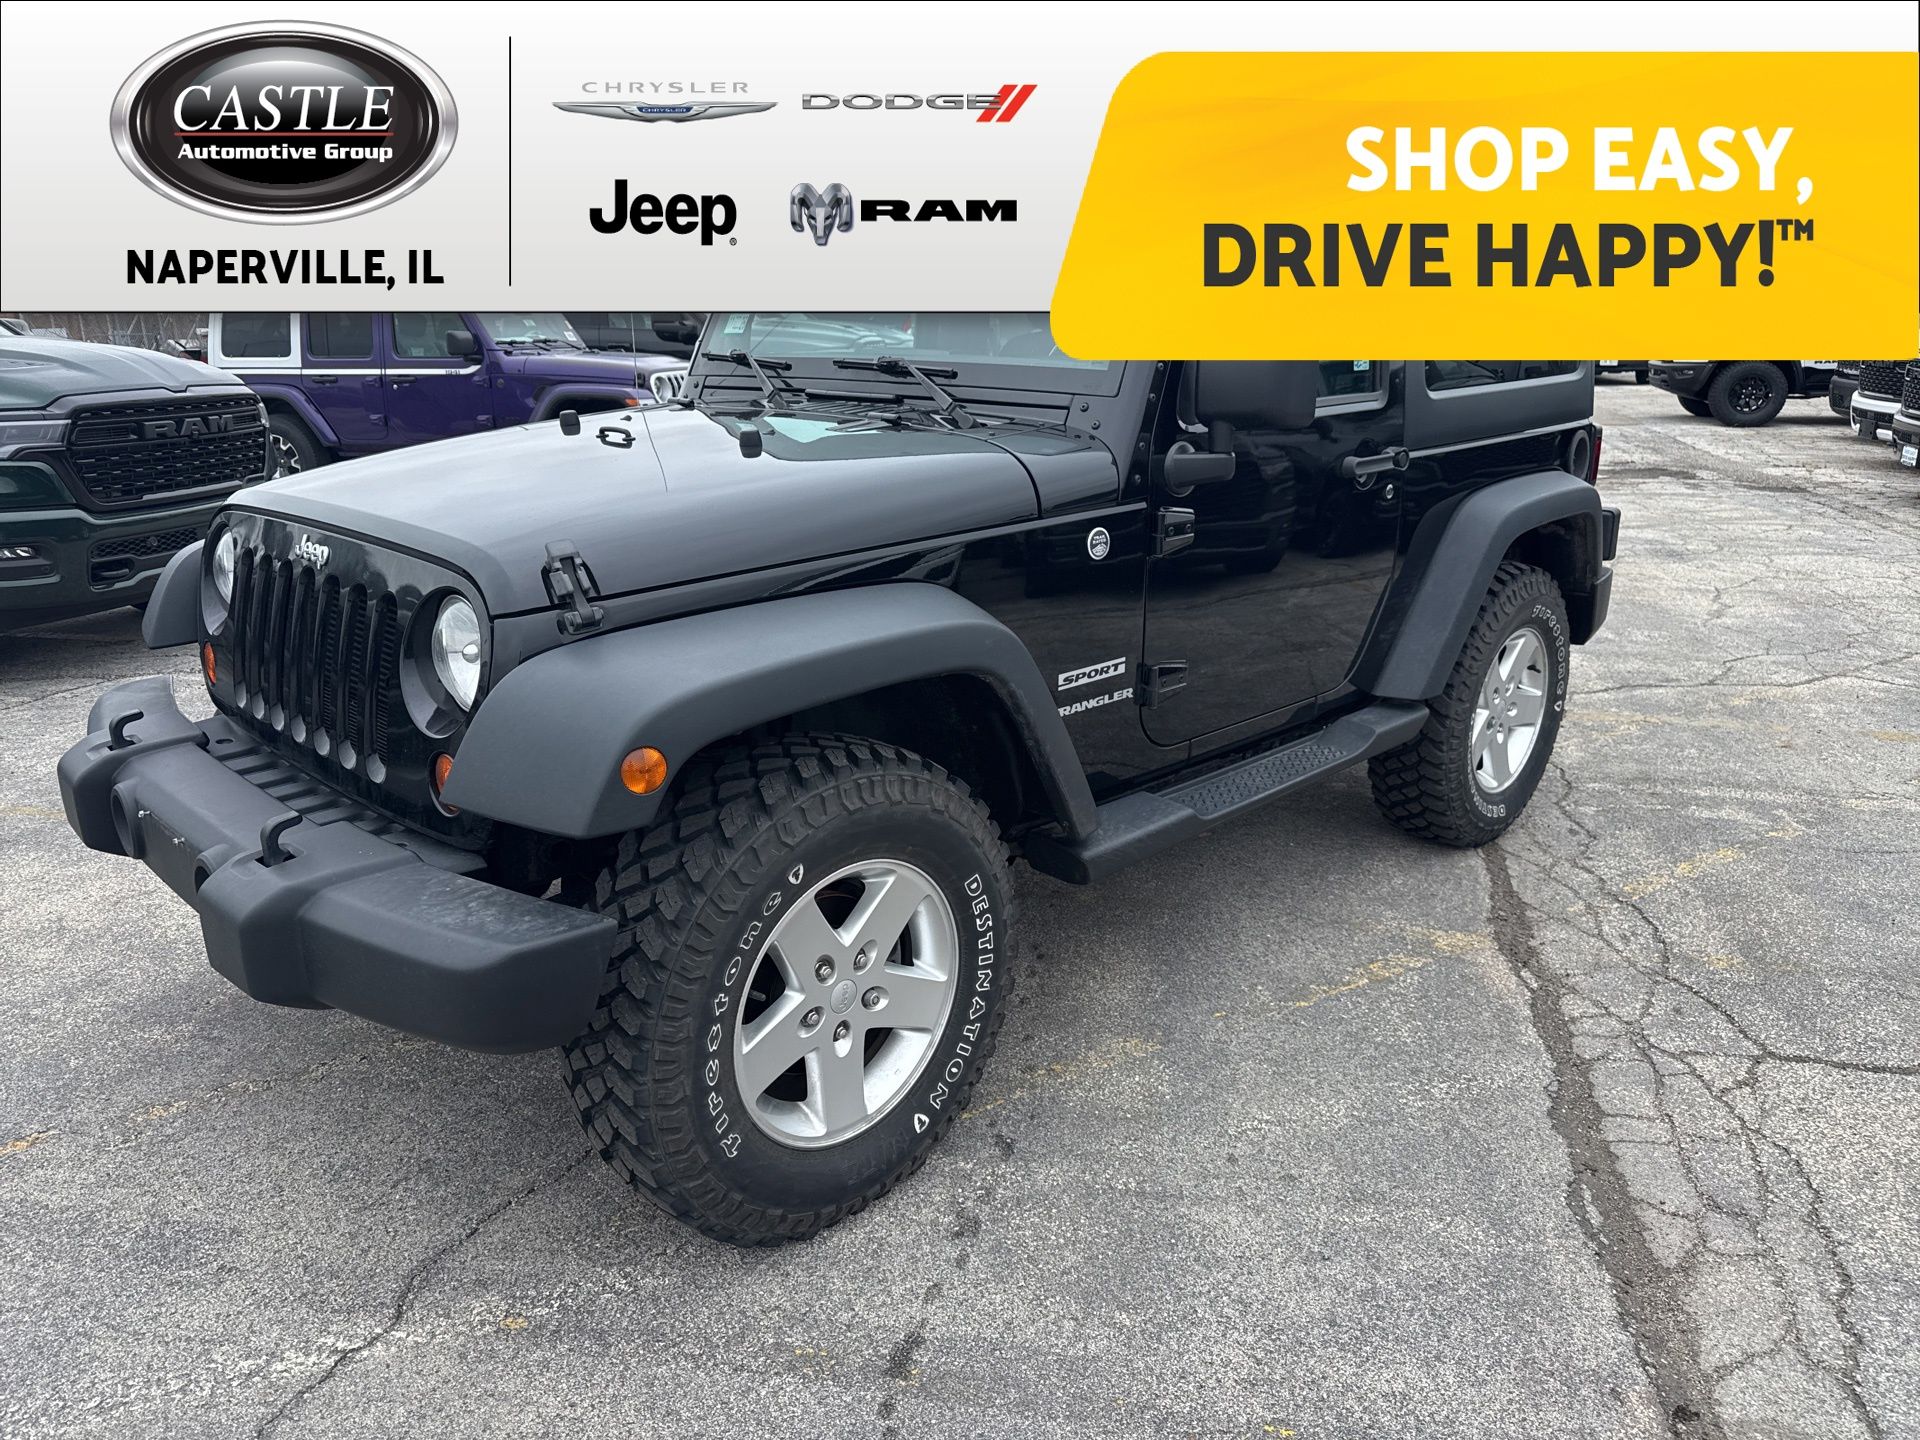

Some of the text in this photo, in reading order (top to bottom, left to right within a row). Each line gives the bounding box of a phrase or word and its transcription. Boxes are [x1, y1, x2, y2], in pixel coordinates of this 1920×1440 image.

[143, 415, 234, 440] RAM
[295, 534, 329, 570] Jeep
[1531, 605, 1566, 696] Firestone
[1061, 662, 1123, 687] SPORT
[1058, 688, 1134, 717] RANGLER
[929, 873, 995, 1110] DESTINATION
[705, 891, 782, 1158] Firestone
